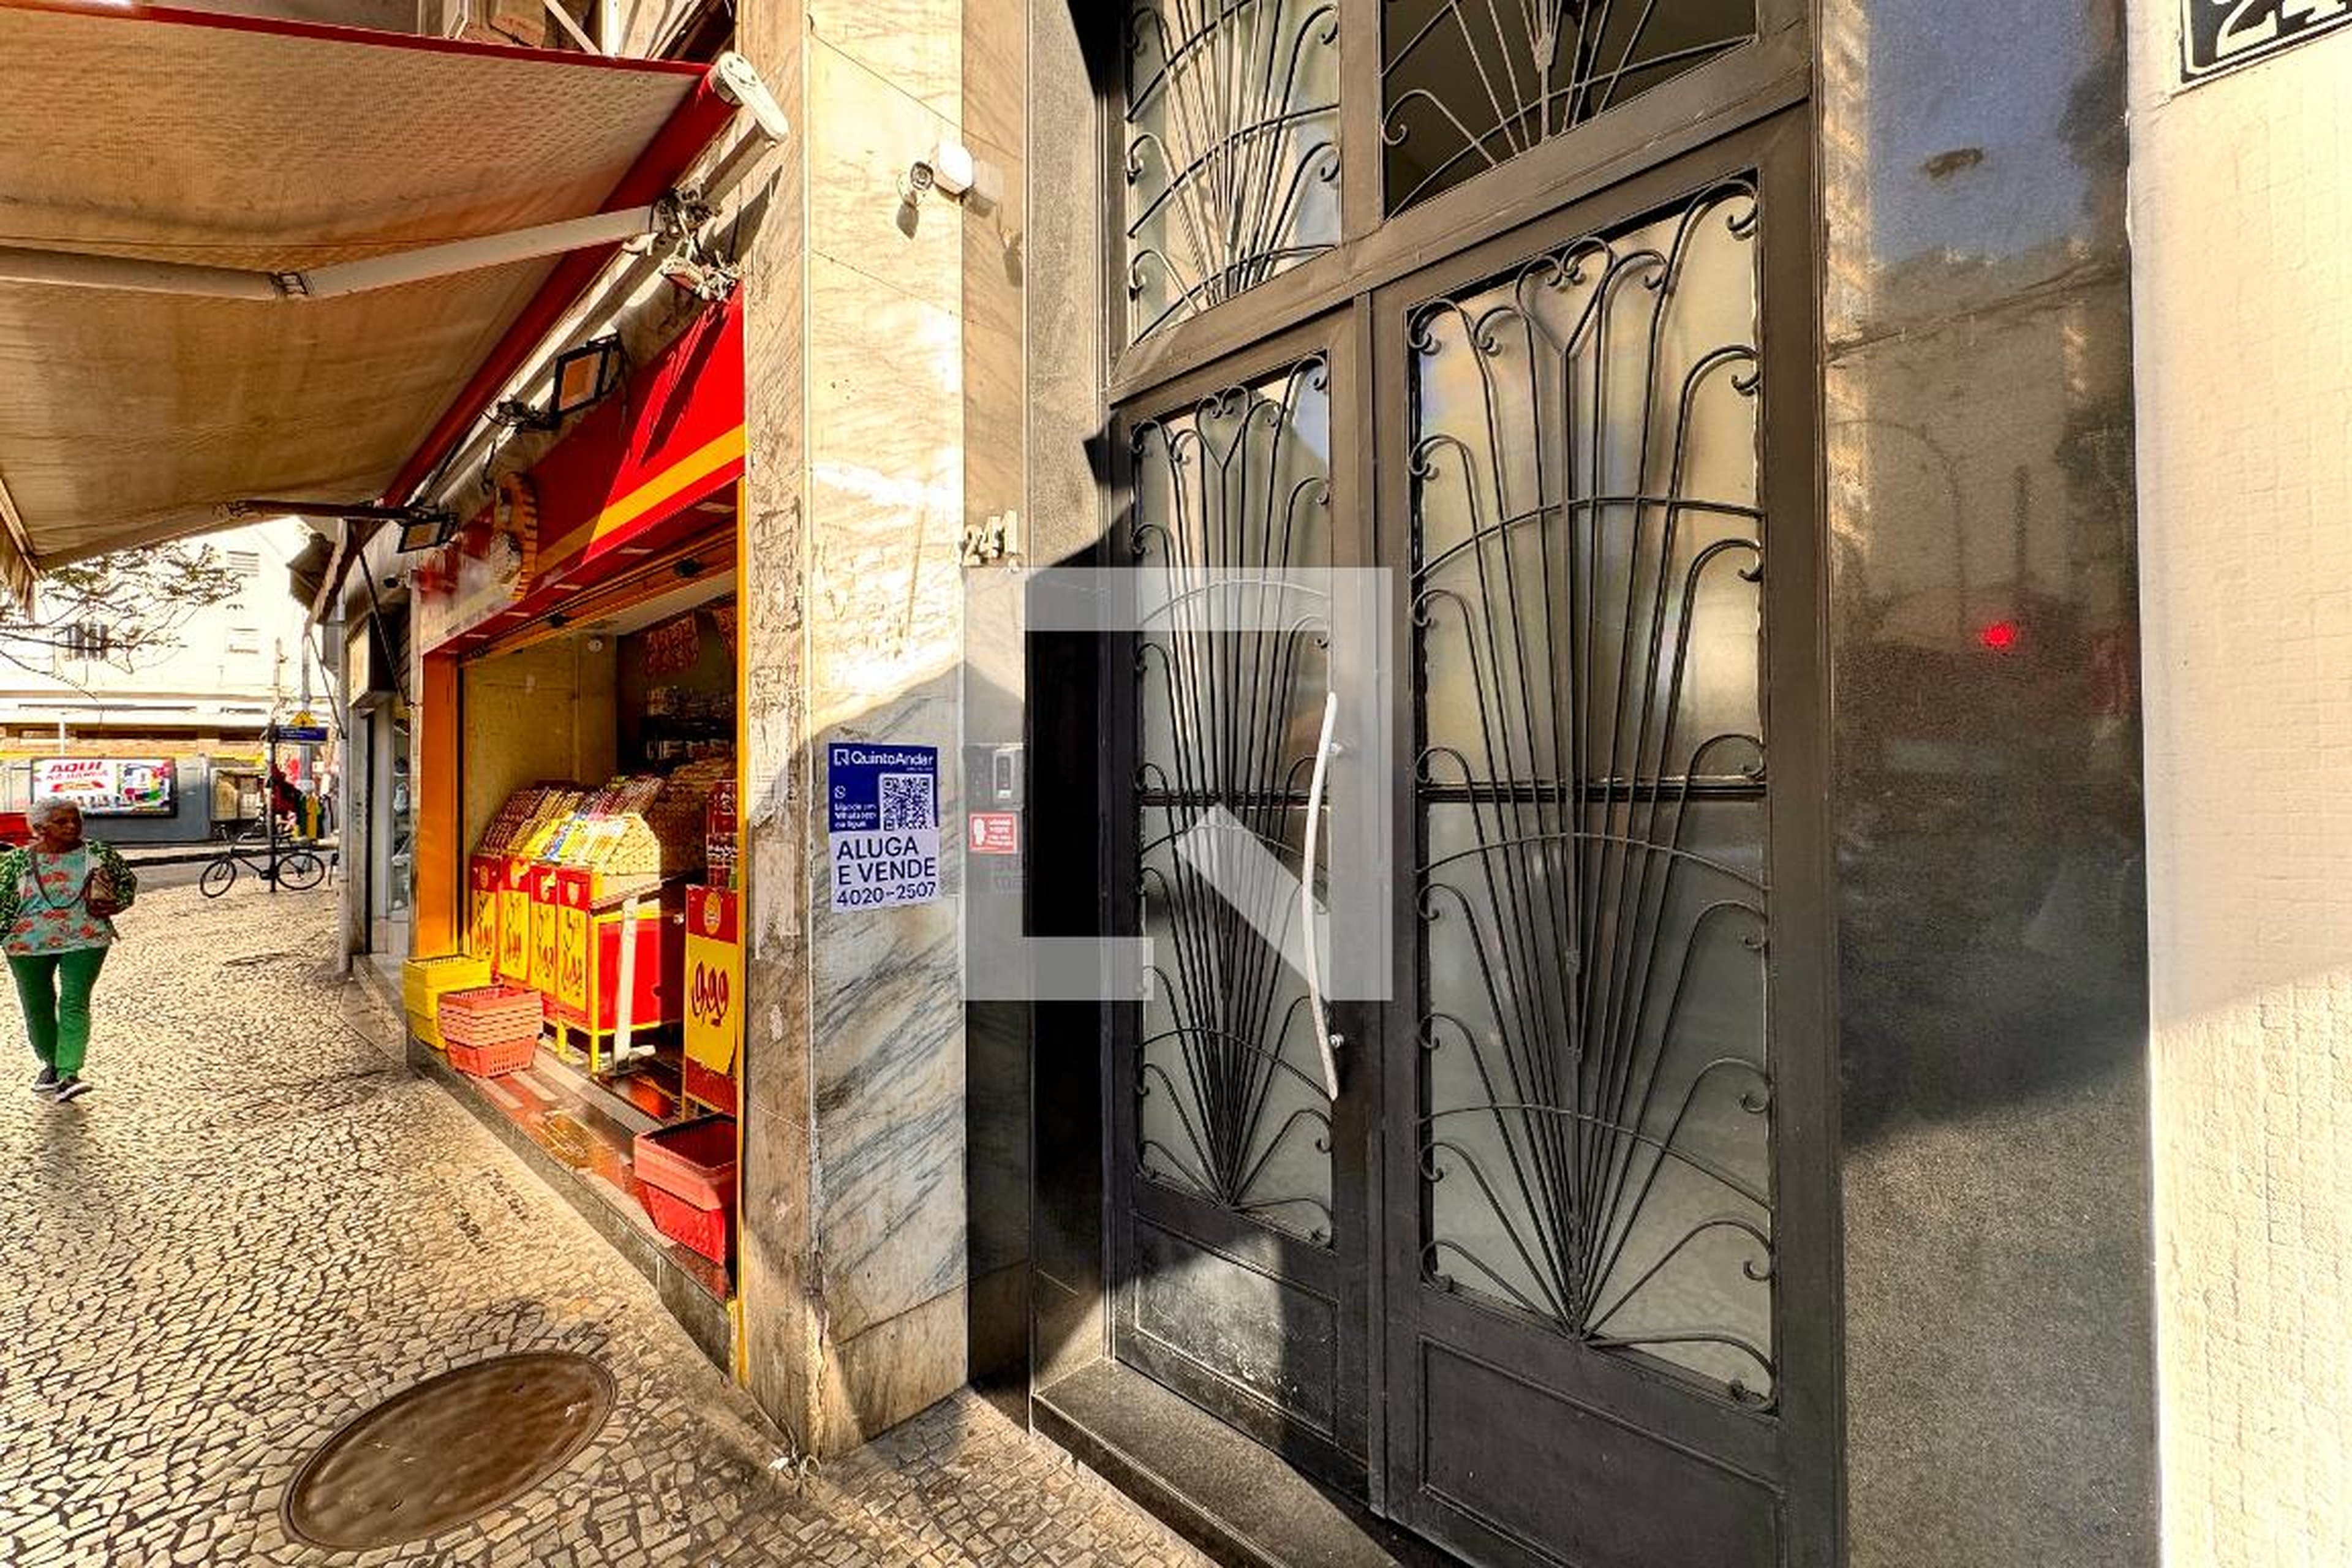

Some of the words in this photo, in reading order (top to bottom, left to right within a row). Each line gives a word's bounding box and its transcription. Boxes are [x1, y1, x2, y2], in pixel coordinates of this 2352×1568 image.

[962, 510, 1017, 567] 241
[49, 761, 102, 774] AQUI
[851, 751, 933, 766] QuintoAndar
[837, 835, 919, 861] ALUGA
[839, 865, 851, 886] E
[857, 858, 936, 883] VENDE
[837, 881, 936, 907] 4020-2507
